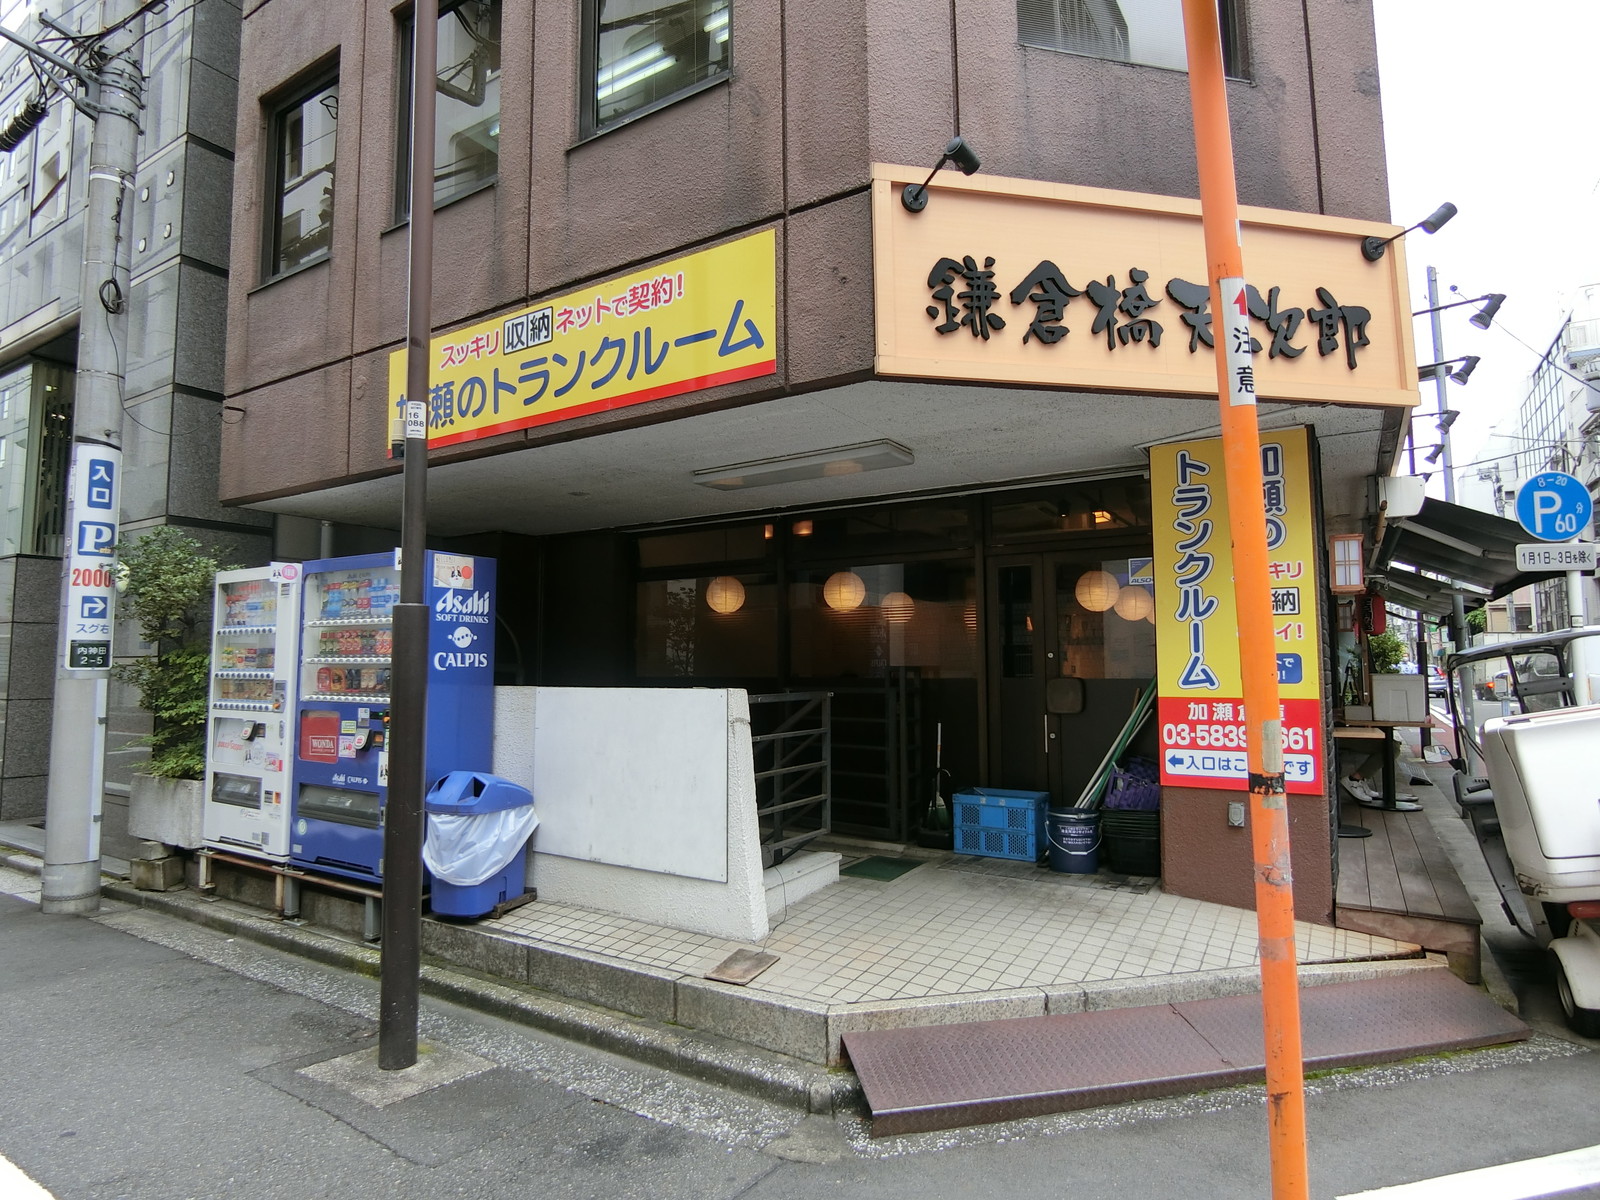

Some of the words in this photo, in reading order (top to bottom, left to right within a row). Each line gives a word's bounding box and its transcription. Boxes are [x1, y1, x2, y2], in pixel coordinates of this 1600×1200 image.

[440, 330, 500, 370] スッキリ
[505, 312, 551, 350] 収納
[555, 273, 684, 333] ネットで契約!
[407, 420, 425, 428] 088
[91, 465, 112, 503] 入口
[1533, 490, 1562, 534] P
[1173, 452, 1219, 687] トランクルーム
[435, 588, 490, 616] Asahi
[436, 613, 458, 622] SOFT
[459, 615, 489, 624] DRINKS
[76, 623, 110, 635] スグ右
[77, 647, 107, 655] 内神田
[80, 656, 103, 665] 2-5
[434, 652, 488, 671] CALPIS
[1185, 755, 1311, 776] 入口はこです
